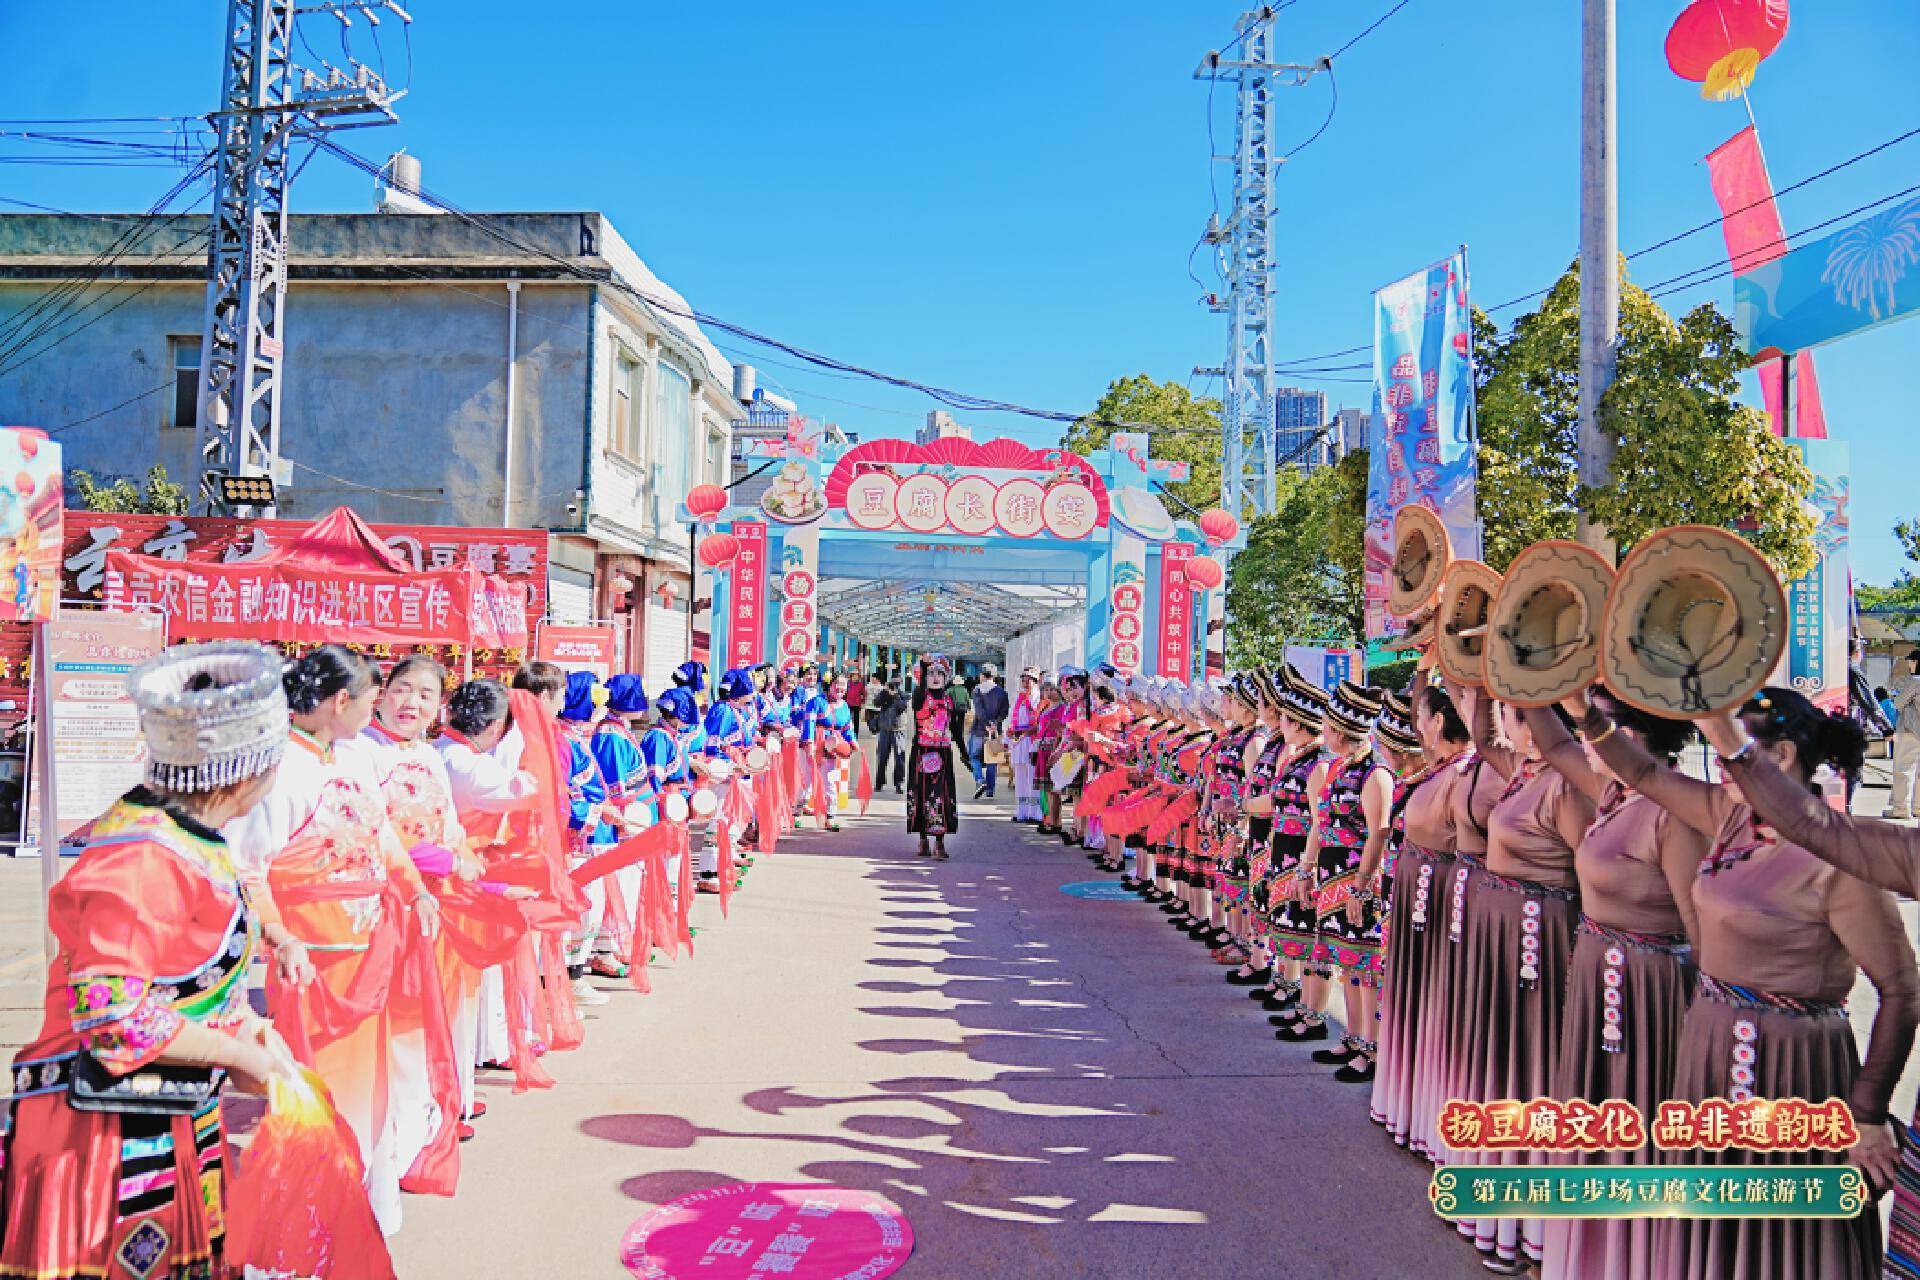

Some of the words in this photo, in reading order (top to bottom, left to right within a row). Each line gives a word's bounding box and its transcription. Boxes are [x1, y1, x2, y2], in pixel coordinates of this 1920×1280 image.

[858, 486, 1085, 528] 豆腐长街宴
[104, 570, 451, 632] 呈贡农信金融知识进社区宣传
[787, 575, 810, 672] 扬豆腐
[1116, 589, 1137, 679] 品非遗
[1167, 570, 1184, 683] 同心共筑中国
